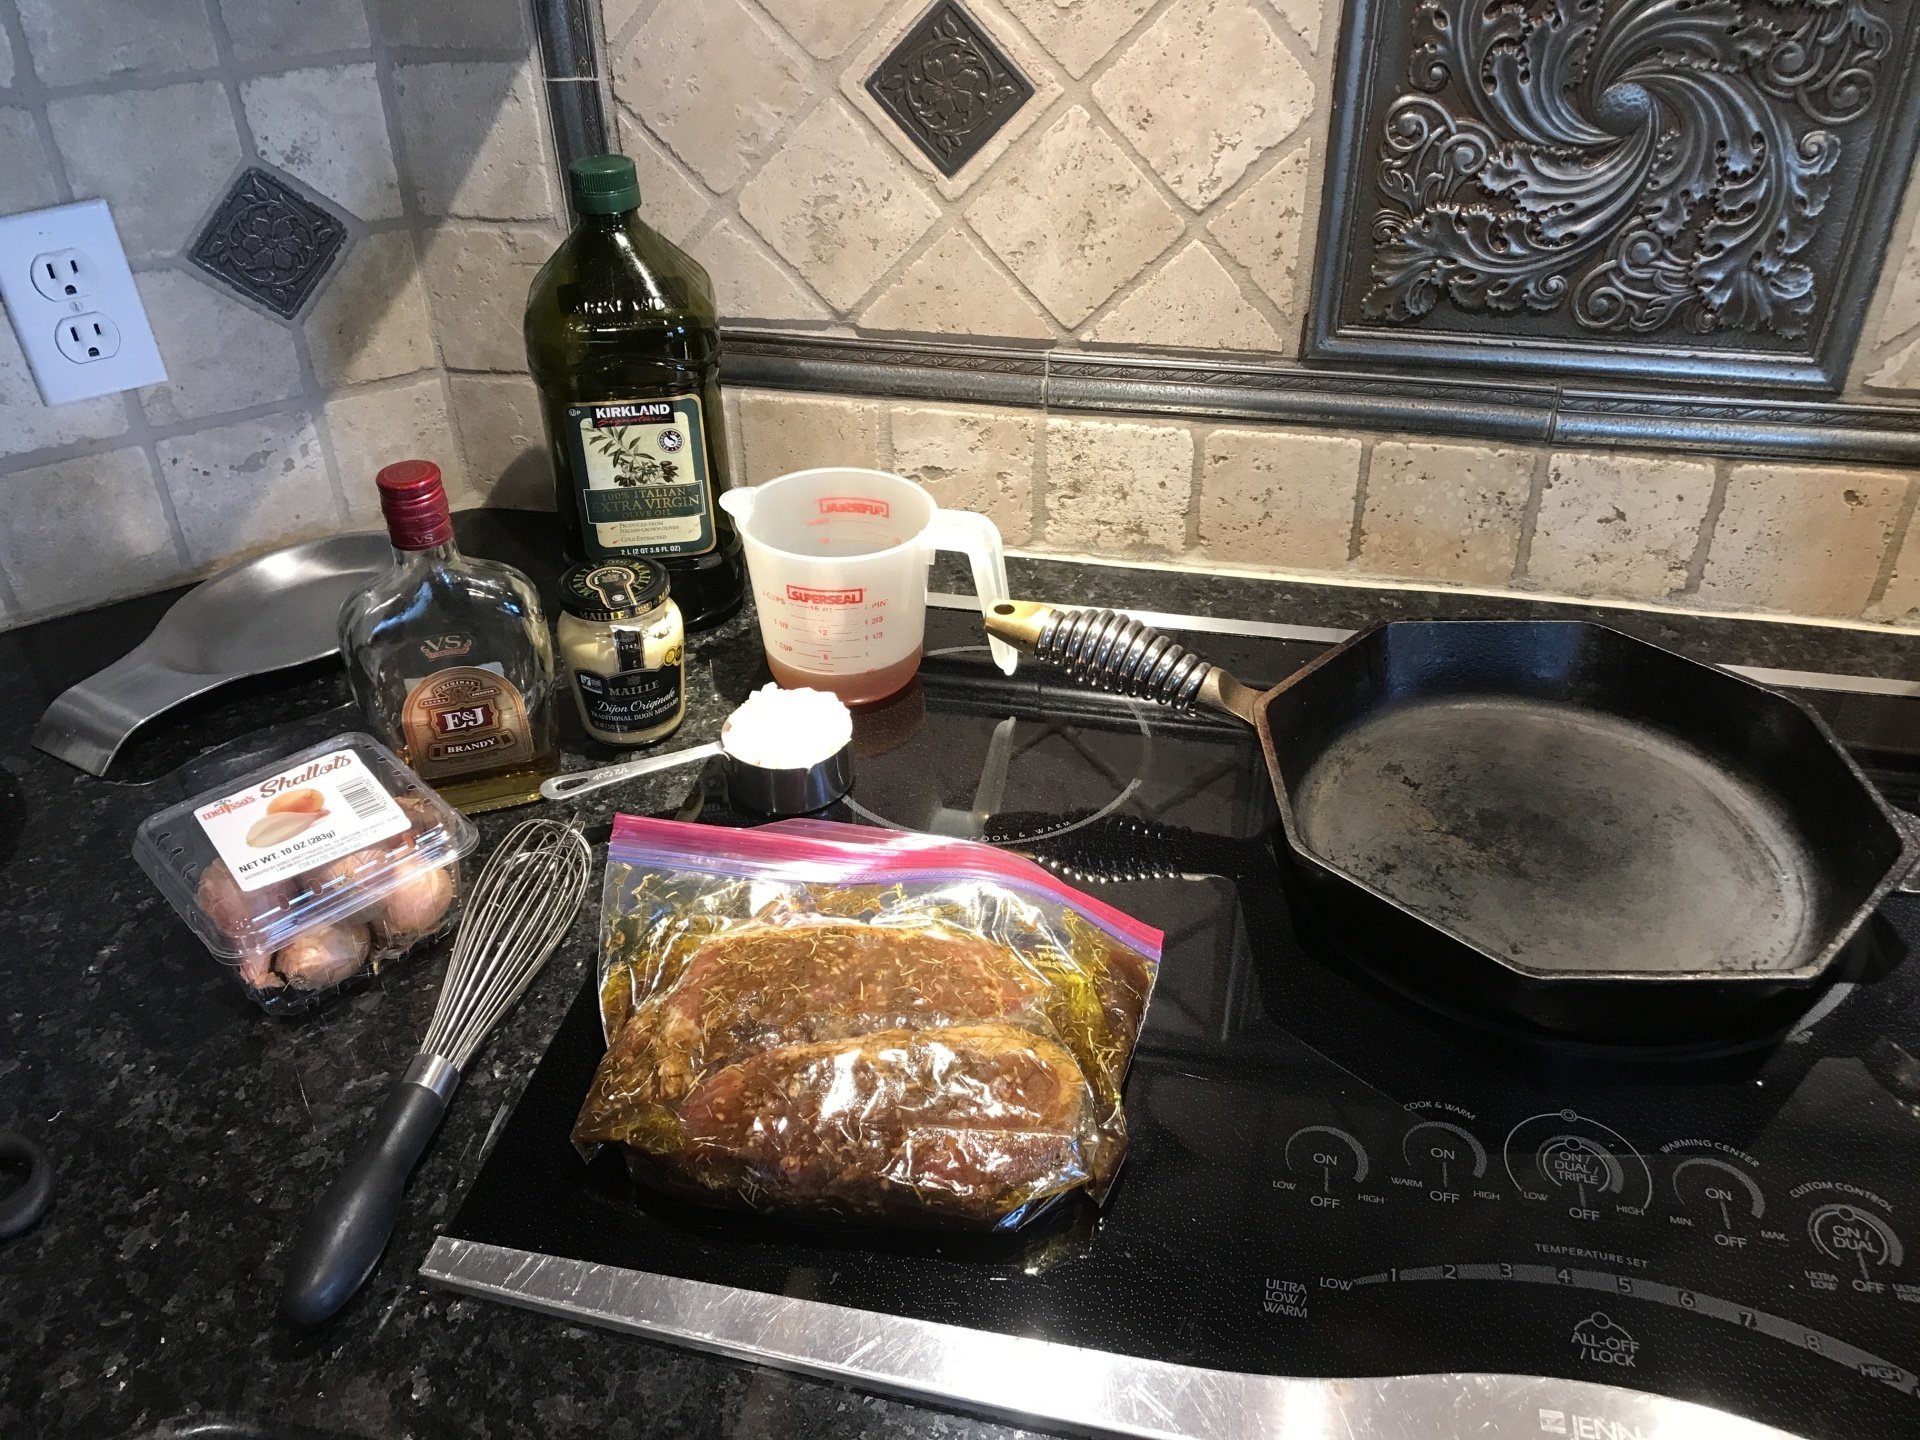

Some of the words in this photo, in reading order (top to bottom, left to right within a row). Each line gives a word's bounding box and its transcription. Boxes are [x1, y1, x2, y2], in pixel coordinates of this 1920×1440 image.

[595, 404, 670, 418] KIRKLAND
[634, 487, 686, 498] ITALIAN
[592, 501, 642, 513] EXTRA
[644, 494, 700, 510] VIRGIN
[623, 510, 652, 519] OLIVE
[413, 534, 434, 544] VS
[670, 545, 681, 553] OZ)
[791, 591, 857, 605] SUPERSEAL
[424, 635, 461, 651] VS
[436, 680, 475, 692] ORIGINAL
[609, 680, 660, 696] MAILLE
[591, 710, 633, 721] TRADITIONAL
[634, 711, 654, 721] DIJON
[654, 697, 679, 716] MUSTARD
[597, 700, 628, 715] Dijon
[442, 707, 484, 731] E&J
[447, 737, 496, 753] BRANDY
[259, 754, 352, 798] Shallots
[202, 794, 256, 821] melissa's
[1034, 820, 1071, 834] WARM
[238, 860, 260, 873] NET
[260, 852, 280, 865] WT.
[280, 847, 292, 857] 10
[293, 841, 307, 851] OZ
[308, 830, 336, 846] (283g)
[1403, 1101, 1432, 1111] COOK
[1434, 1101, 1442, 1110] &
[1444, 1103, 1476, 1121] WARM
[1313, 1153, 1338, 1166] ON
[1430, 1147, 1455, 1160] ON
[1559, 1151, 1582, 1163] ON
[1660, 1139, 1712, 1154] WARMING
[1714, 1142, 1760, 1168] CENTER
[1554, 1159, 1592, 1174] DUAL
[1391, 1176, 1423, 1188] WARM
[1557, 1170, 1599, 1185] TRIPLE
[1273, 1180, 1297, 1190] LOW
[1358, 1193, 1384, 1204] HIGH
[1429, 1190, 1460, 1203] OFF
[1473, 1189, 1500, 1200] HIGH
[1523, 1191, 1548, 1201] LOW
[1705, 1187, 1732, 1201] ON
[1789, 1181, 1833, 1198] CUSTOM
[1835, 1182, 1893, 1213] CONTROL
[1310, 1195, 1340, 1209] OFF
[1569, 1207, 1600, 1221] OFF
[1616, 1204, 1645, 1216] HIGH
[1669, 1215, 1695, 1227] MIN.
[1833, 1225, 1861, 1239] ON
[1714, 1234, 1747, 1249] OFF
[1833, 1236, 1879, 1254] DUAL
[1534, 1243, 1624, 1264] TEMPERATURE
[1626, 1256, 1649, 1268] SET
[1804, 1270, 1839, 1283] ULTRA
[1265, 1277, 1307, 1295] ULTRA
[1811, 1280, 1838, 1291] LOW
[1852, 1279, 1886, 1294] OFF
[1265, 1290, 1298, 1304] LOW
[1263, 1301, 1308, 1318] WARM
[1319, 1276, 1353, 1291] LOW
[1390, 1268, 1397, 1282] 1
[1444, 1264, 1457, 1280] 2
[1500, 1262, 1514, 1278] 3
[1557, 1268, 1571, 1283] 4
[1618, 1277, 1632, 1293] 5
[1680, 1292, 1694, 1308] 6
[1738, 1311, 1753, 1327] 7
[1806, 1334, 1821, 1350] 8
[1859, 1364, 1903, 1381] HIGH
[1571, 1330, 1640, 1353] ALL-OFF
[1591, 1349, 1636, 1368] LOCK
